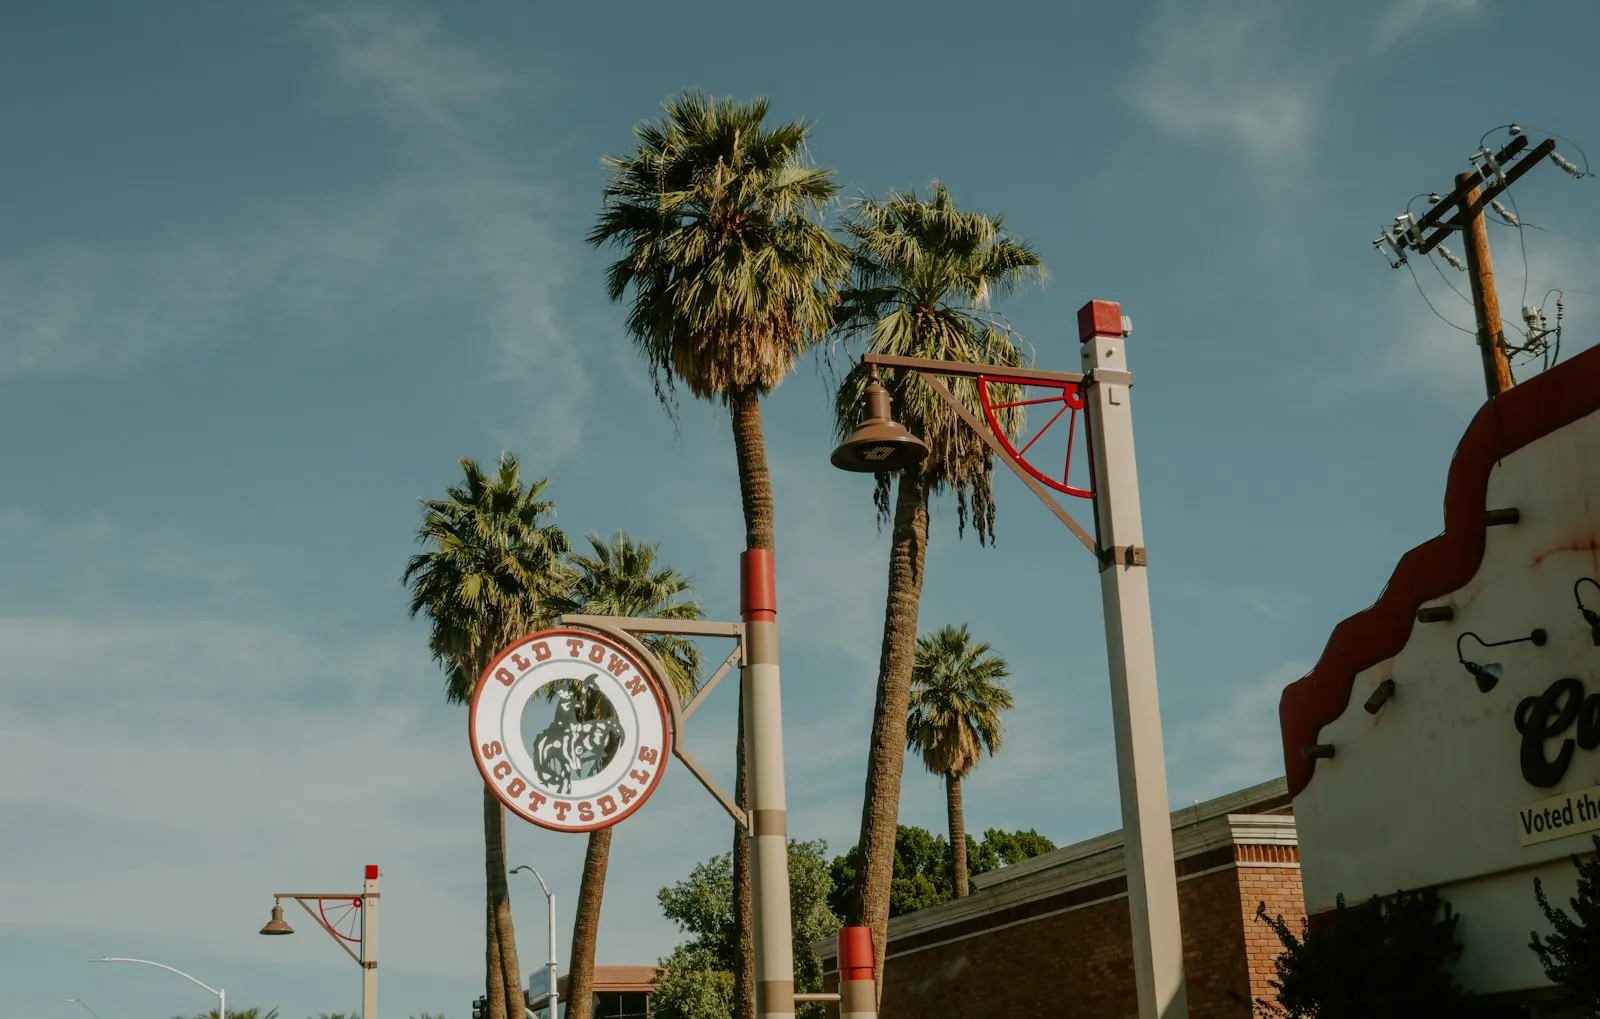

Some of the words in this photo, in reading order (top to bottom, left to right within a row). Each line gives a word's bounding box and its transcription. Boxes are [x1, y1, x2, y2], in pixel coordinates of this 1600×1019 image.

[495, 641, 552, 686] OLD
[566, 639, 647, 696] TOWN
[482, 741, 658, 821] SCOTTSDALE
[1519, 797, 1575, 835] Voted
[1576, 793, 1600, 822] th
